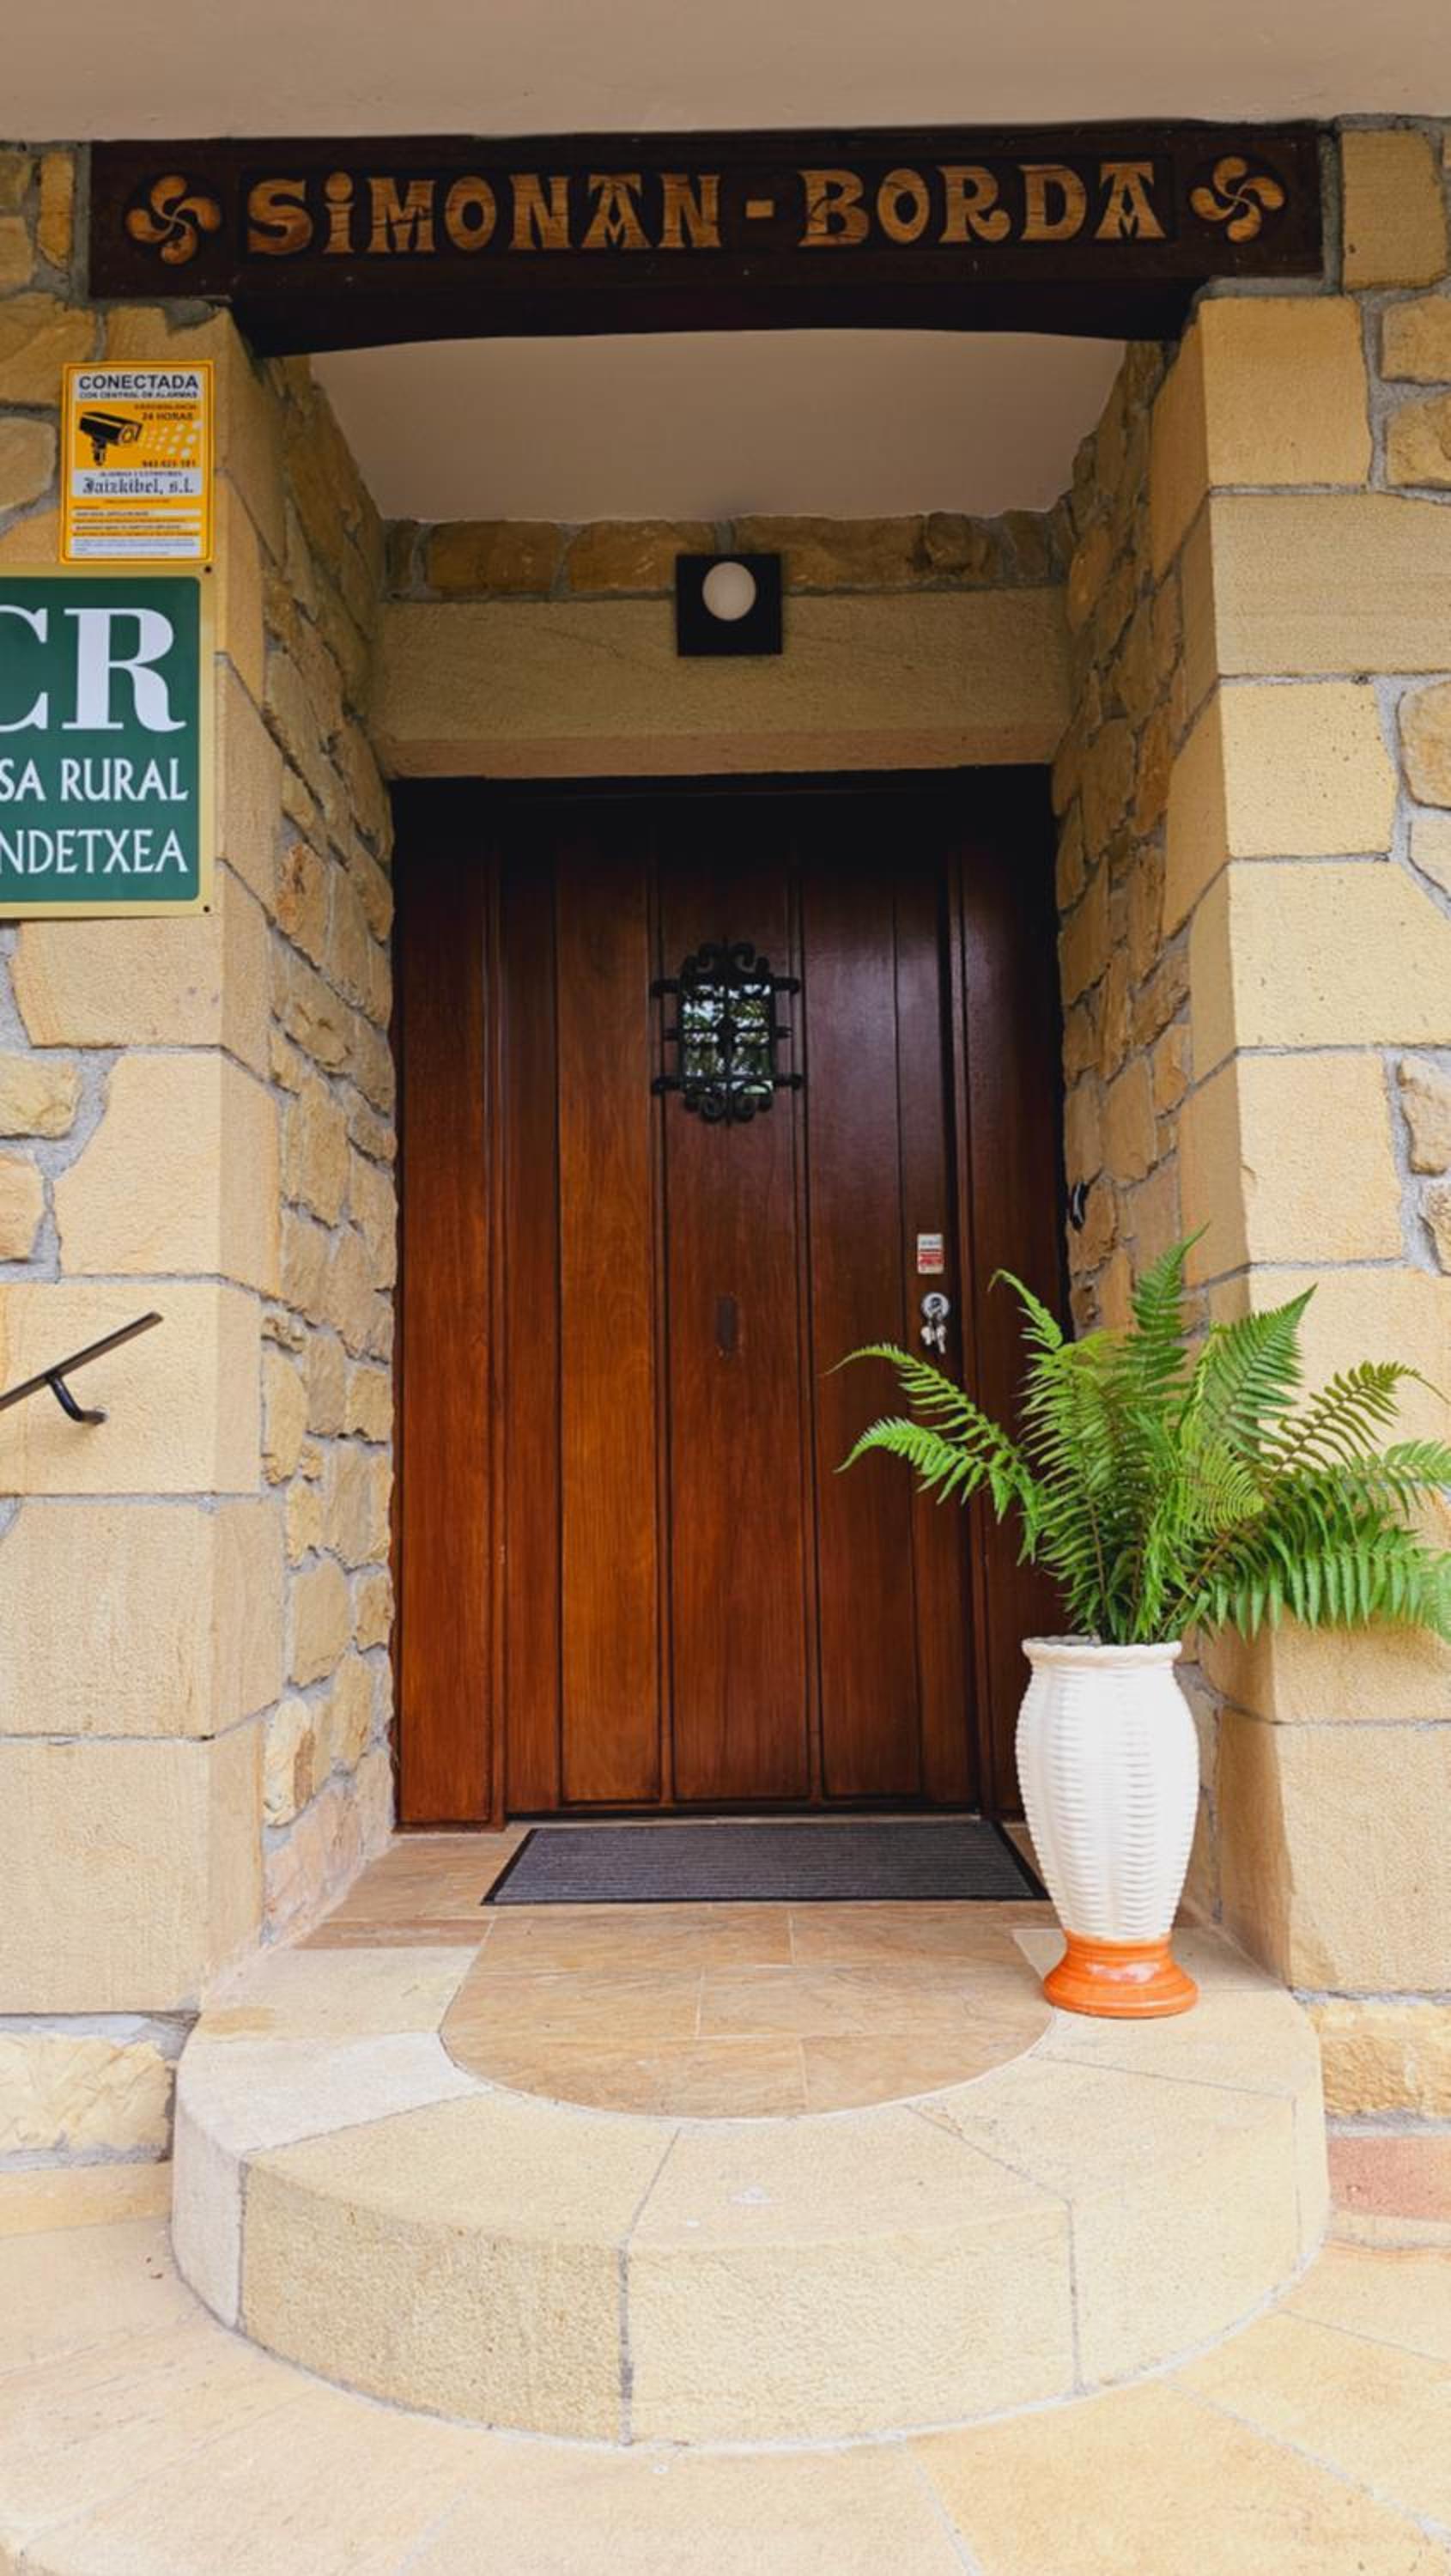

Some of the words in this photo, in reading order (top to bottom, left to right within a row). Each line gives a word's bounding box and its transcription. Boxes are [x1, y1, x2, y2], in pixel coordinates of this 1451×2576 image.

[799, 162, 1166, 247] BORDA
[79, 374, 198, 390] CONECTADA
[100, 391, 138, 399] CENTRAL
[156, 411, 193, 421] HORAS
[60, 757, 189, 802] RURAL
